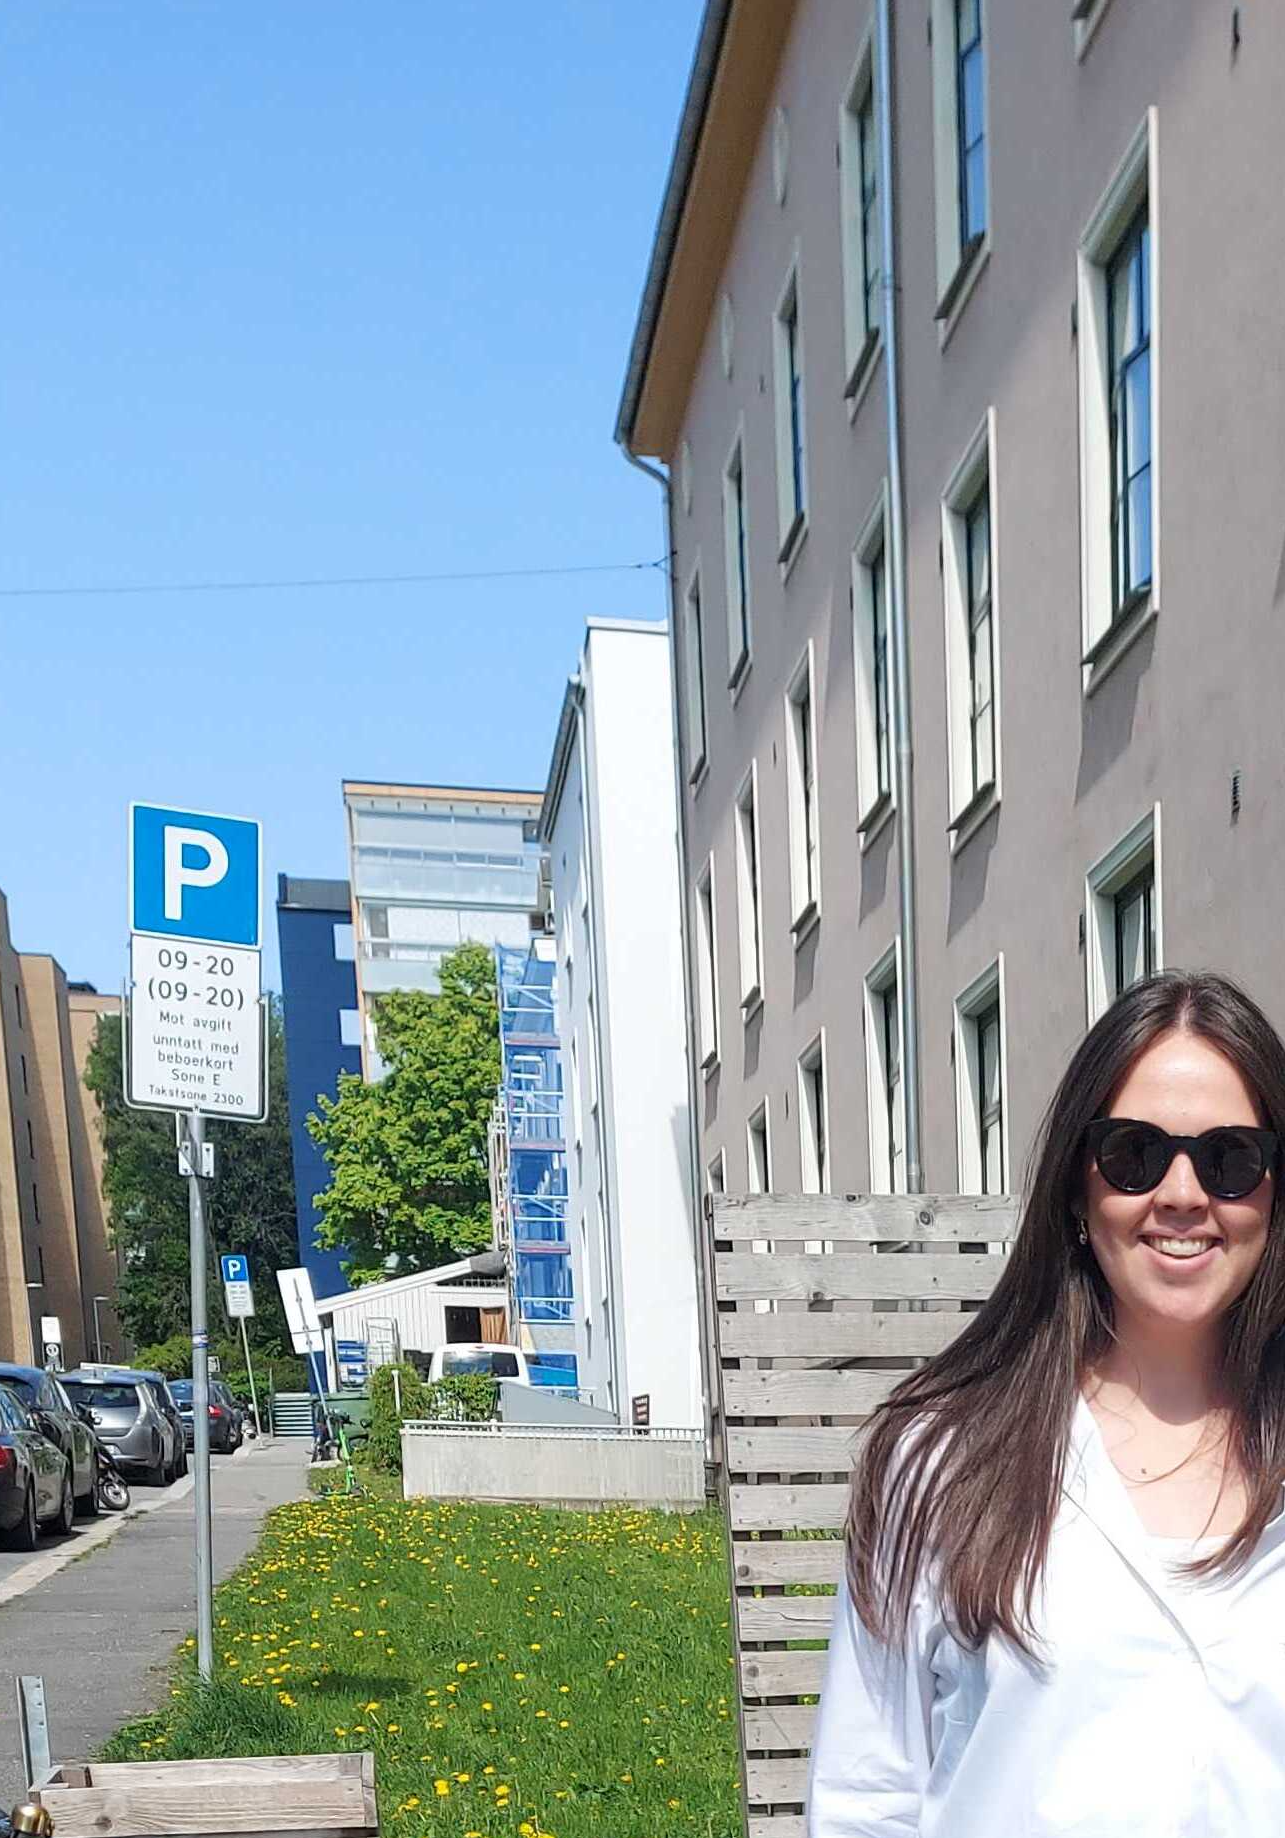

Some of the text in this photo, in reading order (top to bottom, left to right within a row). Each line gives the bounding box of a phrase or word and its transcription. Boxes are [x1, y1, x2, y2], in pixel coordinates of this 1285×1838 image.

[163, 825, 229, 921] P
[158, 948, 235, 977] 09-20
[148, 976, 245, 1011] (09-20)
[159, 1010, 232, 1032] Mot avgift
[152, 1034, 240, 1055] unntatt med
[157, 1049, 233, 1072] beboerkort
[171, 1068, 221, 1086] Sone E
[149, 1084, 244, 1106] Takstsone 2300
[228, 1259, 241, 1280] P
